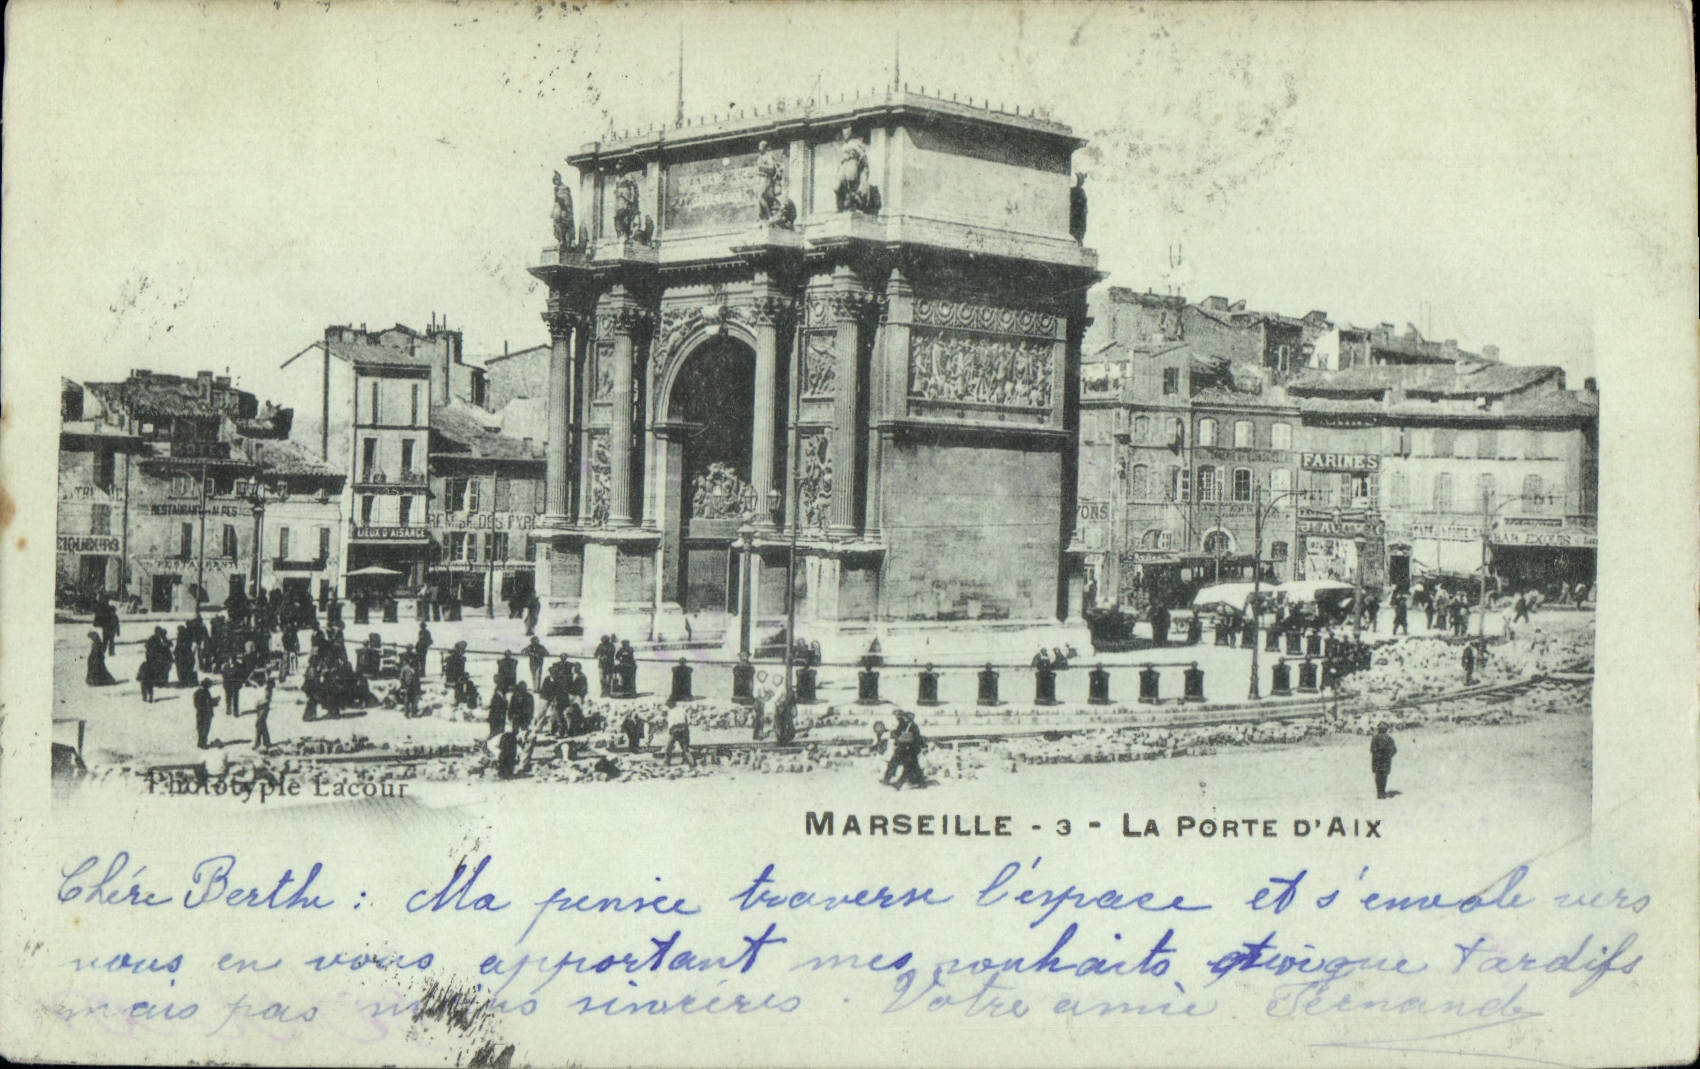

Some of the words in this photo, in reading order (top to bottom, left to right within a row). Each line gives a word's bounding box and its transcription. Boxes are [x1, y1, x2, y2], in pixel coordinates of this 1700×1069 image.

[1302, 453, 1379, 469] FARINES
[479, 514, 503, 530] DES
[405, 853, 513, 914] Ma
[729, 862, 955, 912] traverse
[976, 855, 1213, 930] l'espace
[1245, 867, 1309, 916] et
[1553, 887, 1651, 914] vers
[216, 952, 284, 974] en
[304, 952, 436, 973] vous
[477, 922, 789, 996] apportant
[790, 950, 916, 978] mes
[1452, 932, 1644, 998] tardifs
[206, 993, 320, 1037] pas
[882, 969, 1030, 1020] Votre
